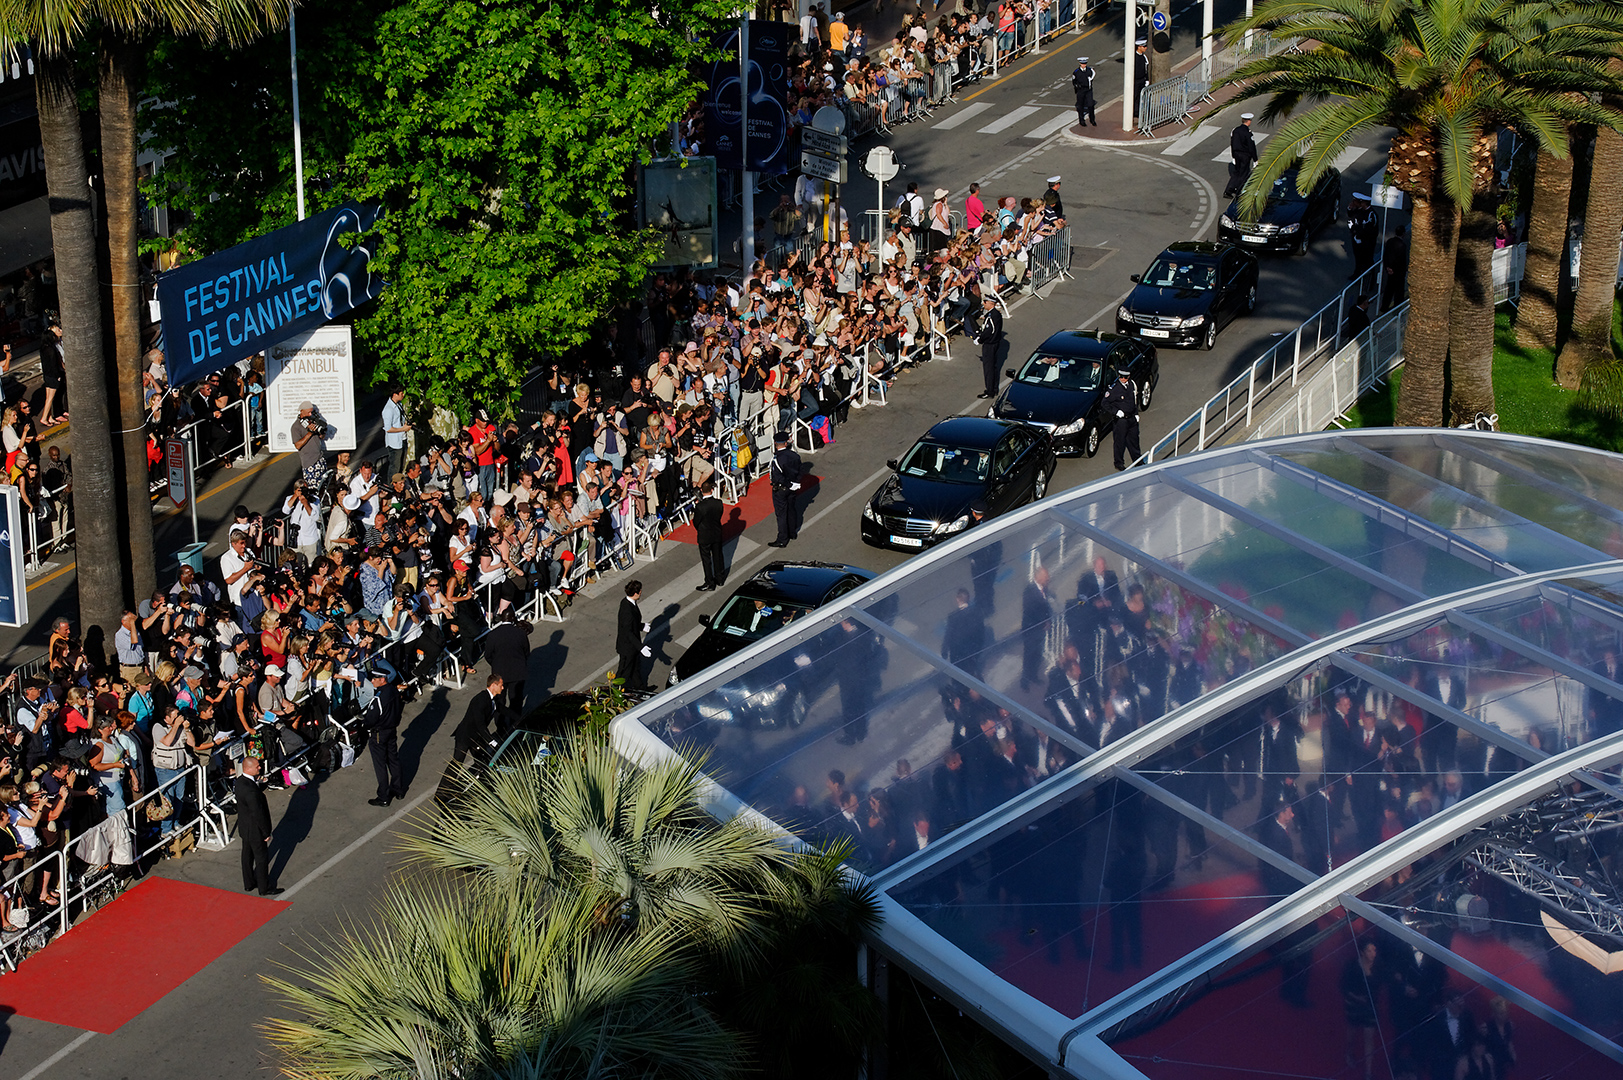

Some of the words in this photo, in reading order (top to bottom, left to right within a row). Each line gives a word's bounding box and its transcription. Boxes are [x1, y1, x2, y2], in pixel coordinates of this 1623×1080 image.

[747, 118, 774, 127] FESTIVAL
[747, 131, 772, 139] CANNES
[0, 144, 45, 182] AVIS
[184, 252, 295, 322] FESTIVAL
[188, 321, 222, 365] DE
[226, 279, 322, 347] CANNES
[280, 358, 339, 375] ISTANBUL
